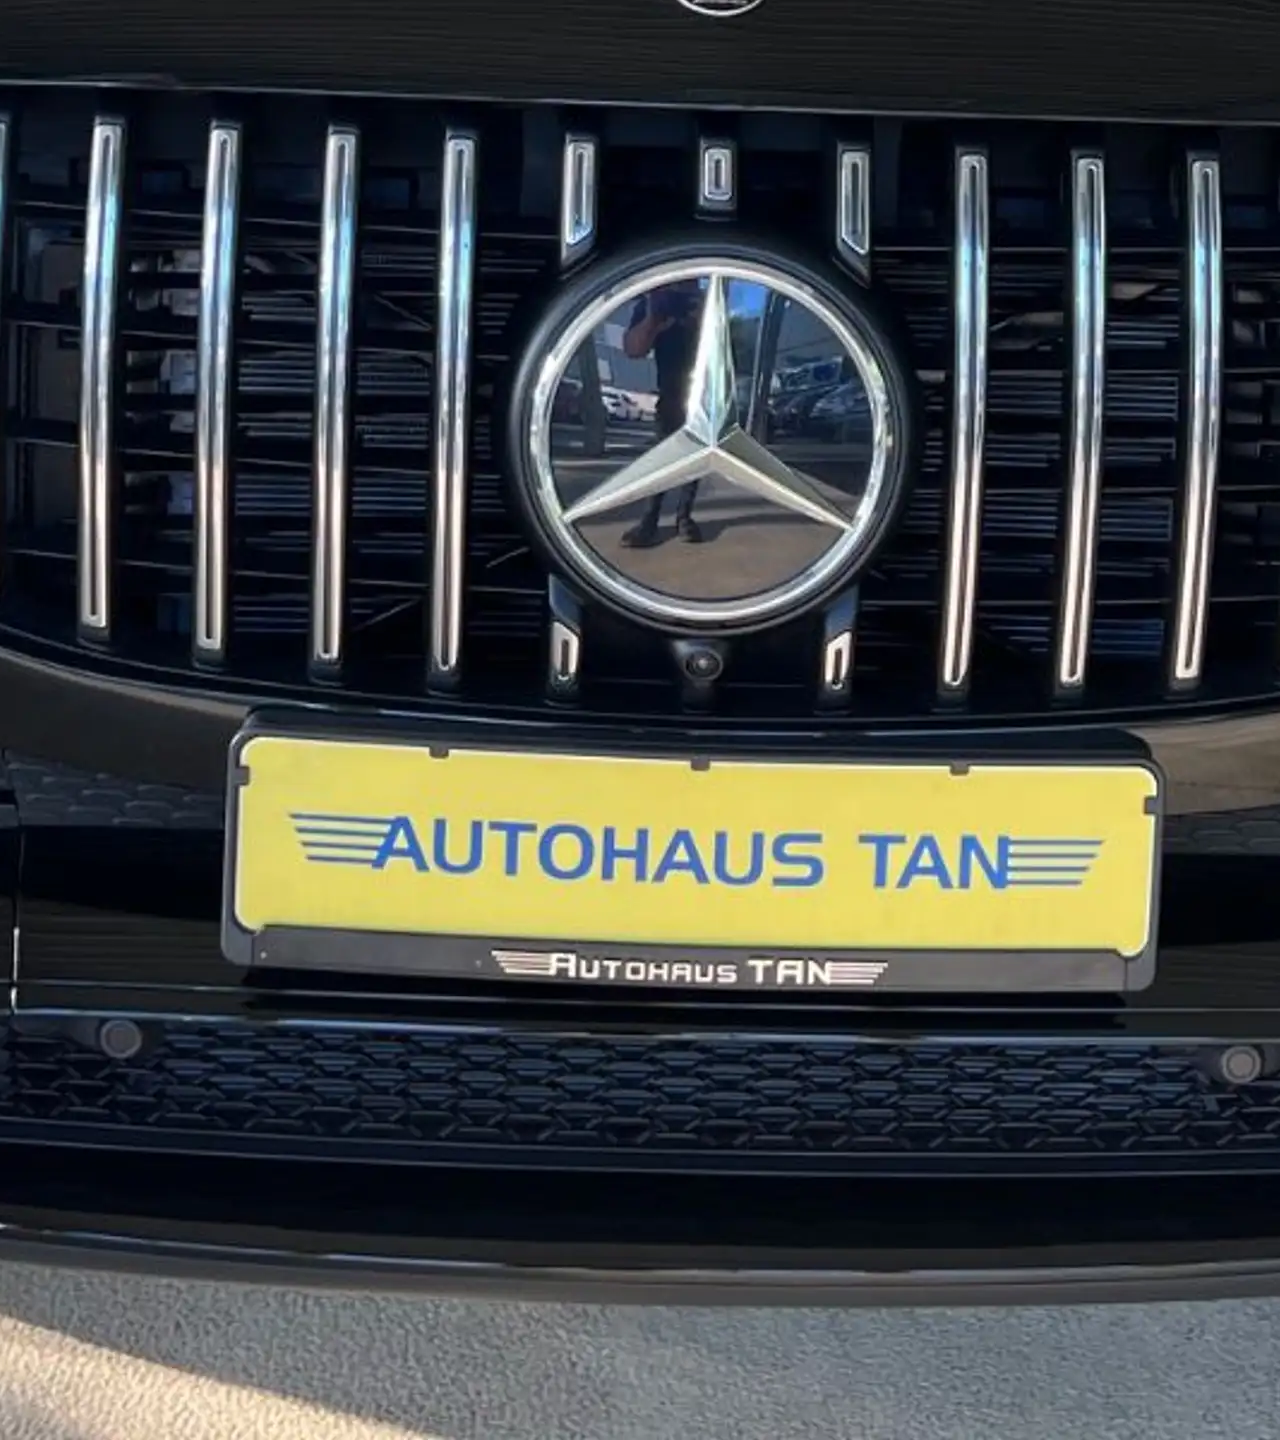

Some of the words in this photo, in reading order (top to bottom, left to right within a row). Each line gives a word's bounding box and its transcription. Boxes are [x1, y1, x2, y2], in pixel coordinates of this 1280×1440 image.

[371, 815, 825, 888] AUTOHAUS
[859, 833, 1012, 891] TAN
[549, 953, 738, 984] AUTOHAUS
[747, 959, 832, 985] TAN
